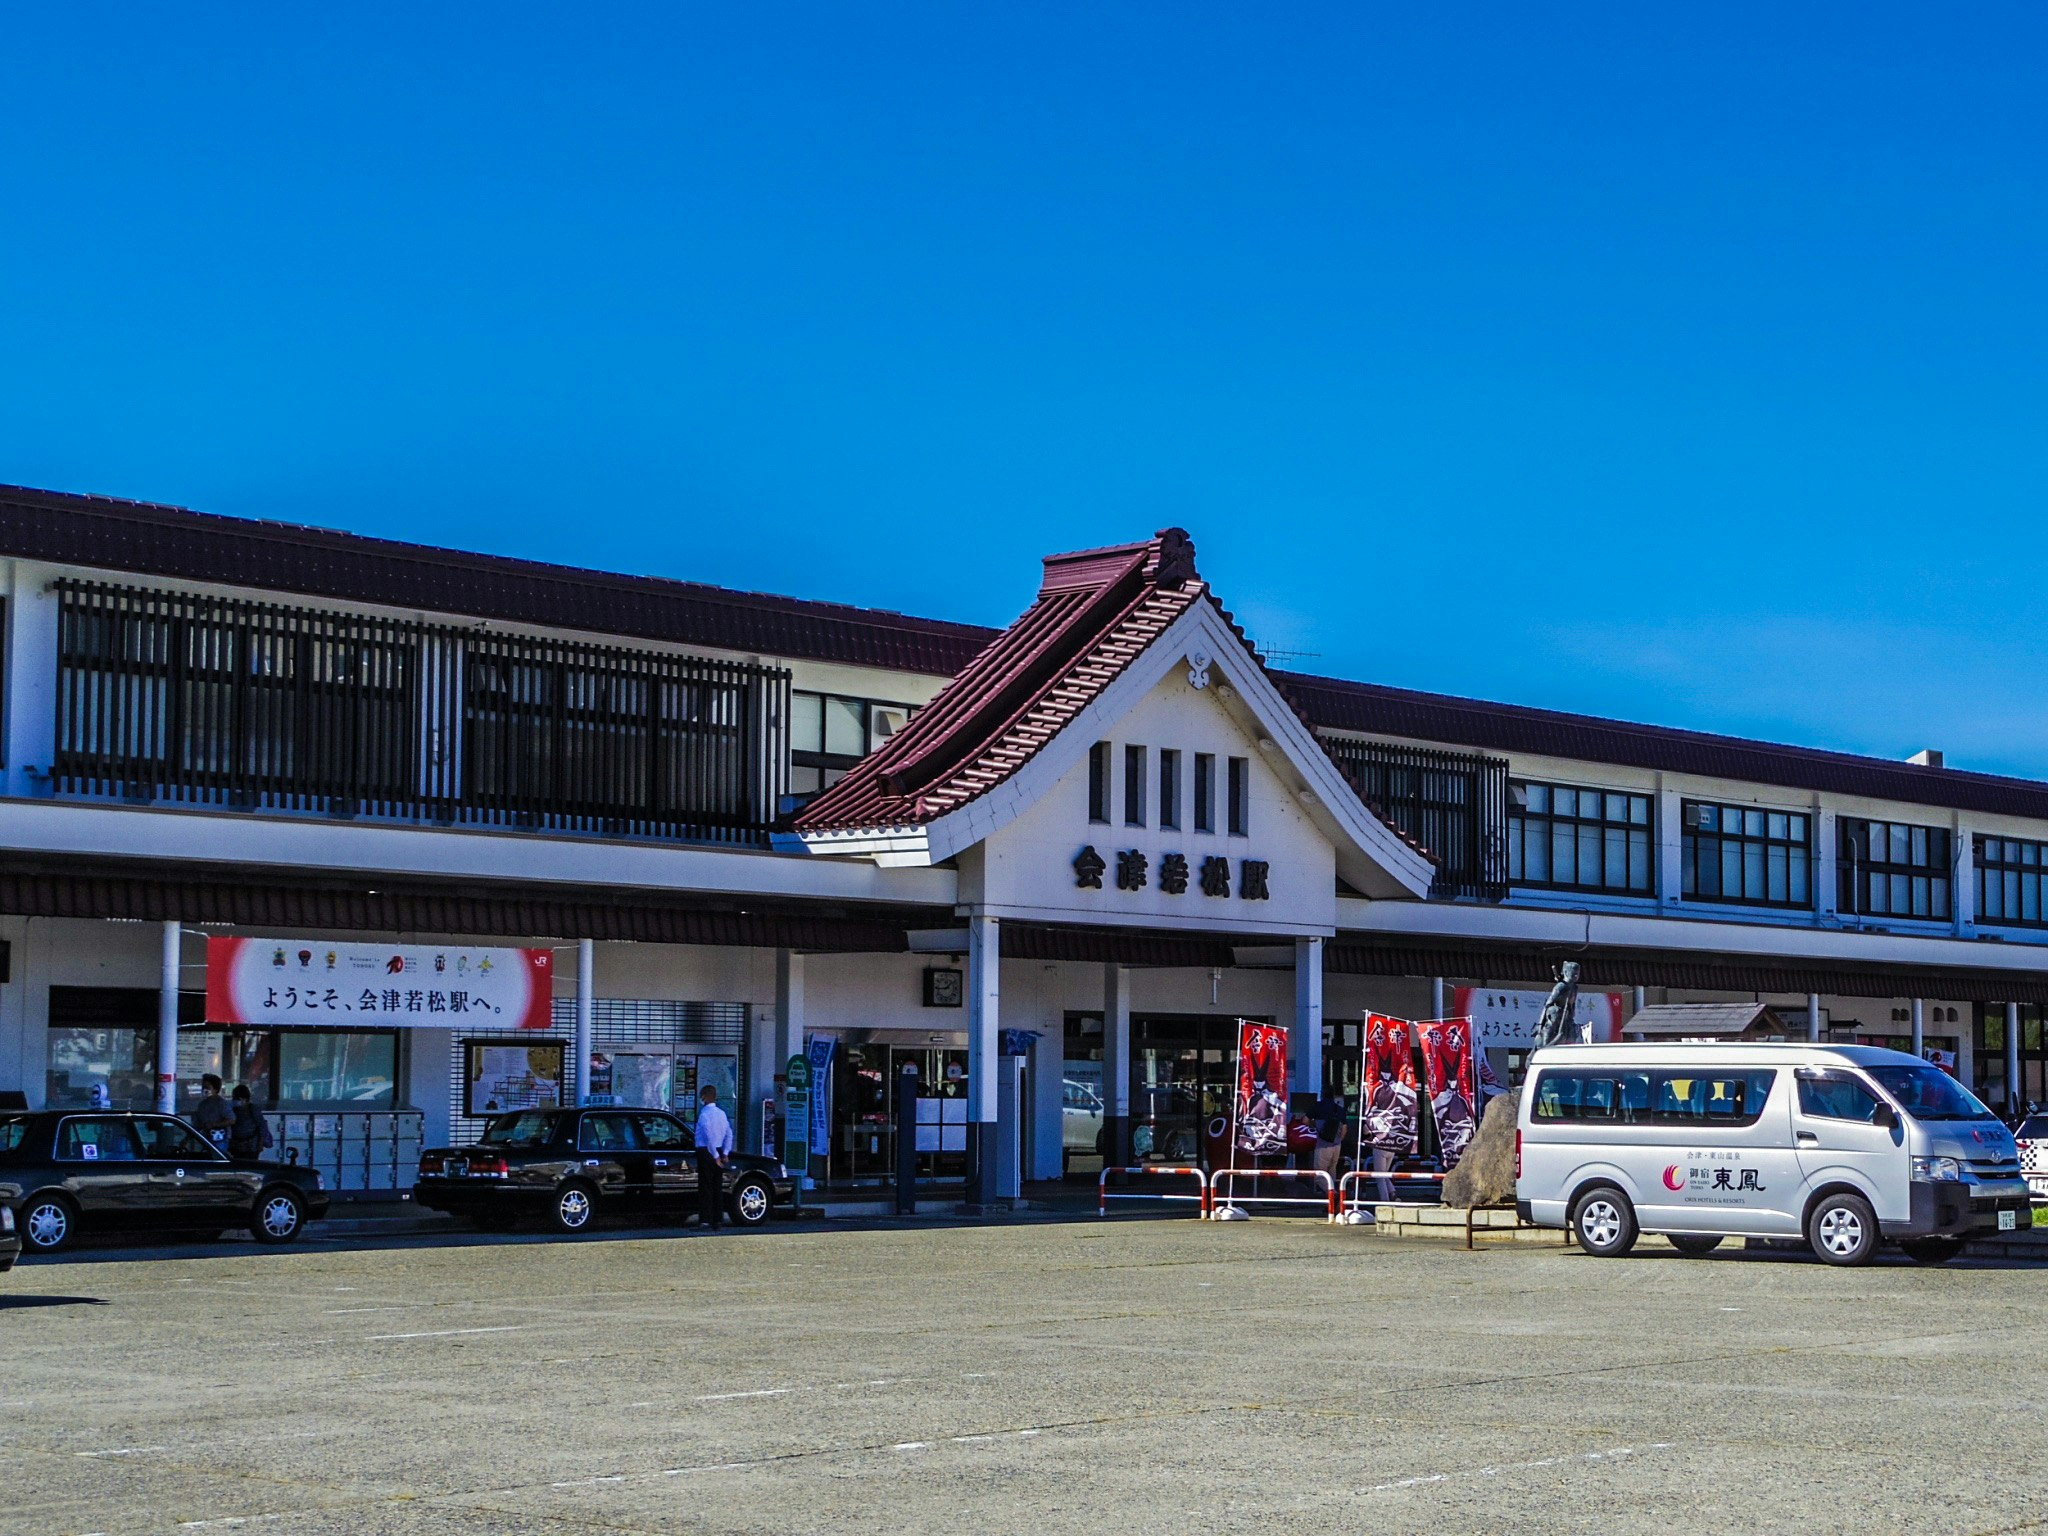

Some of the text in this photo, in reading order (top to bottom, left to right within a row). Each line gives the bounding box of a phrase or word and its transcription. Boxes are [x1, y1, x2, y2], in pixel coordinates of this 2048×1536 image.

[1074, 845, 1269, 900] 会津若松駅
[534, 956, 547, 964] JR
[263, 986, 500, 1014] ようこそ、会津若松駅へ。
[1368, 1021, 1407, 1054] 会津
[1687, 1151, 1741, 1160] 会津・東山温泉
[1689, 1167, 1766, 1191] 御宿 東鳳
